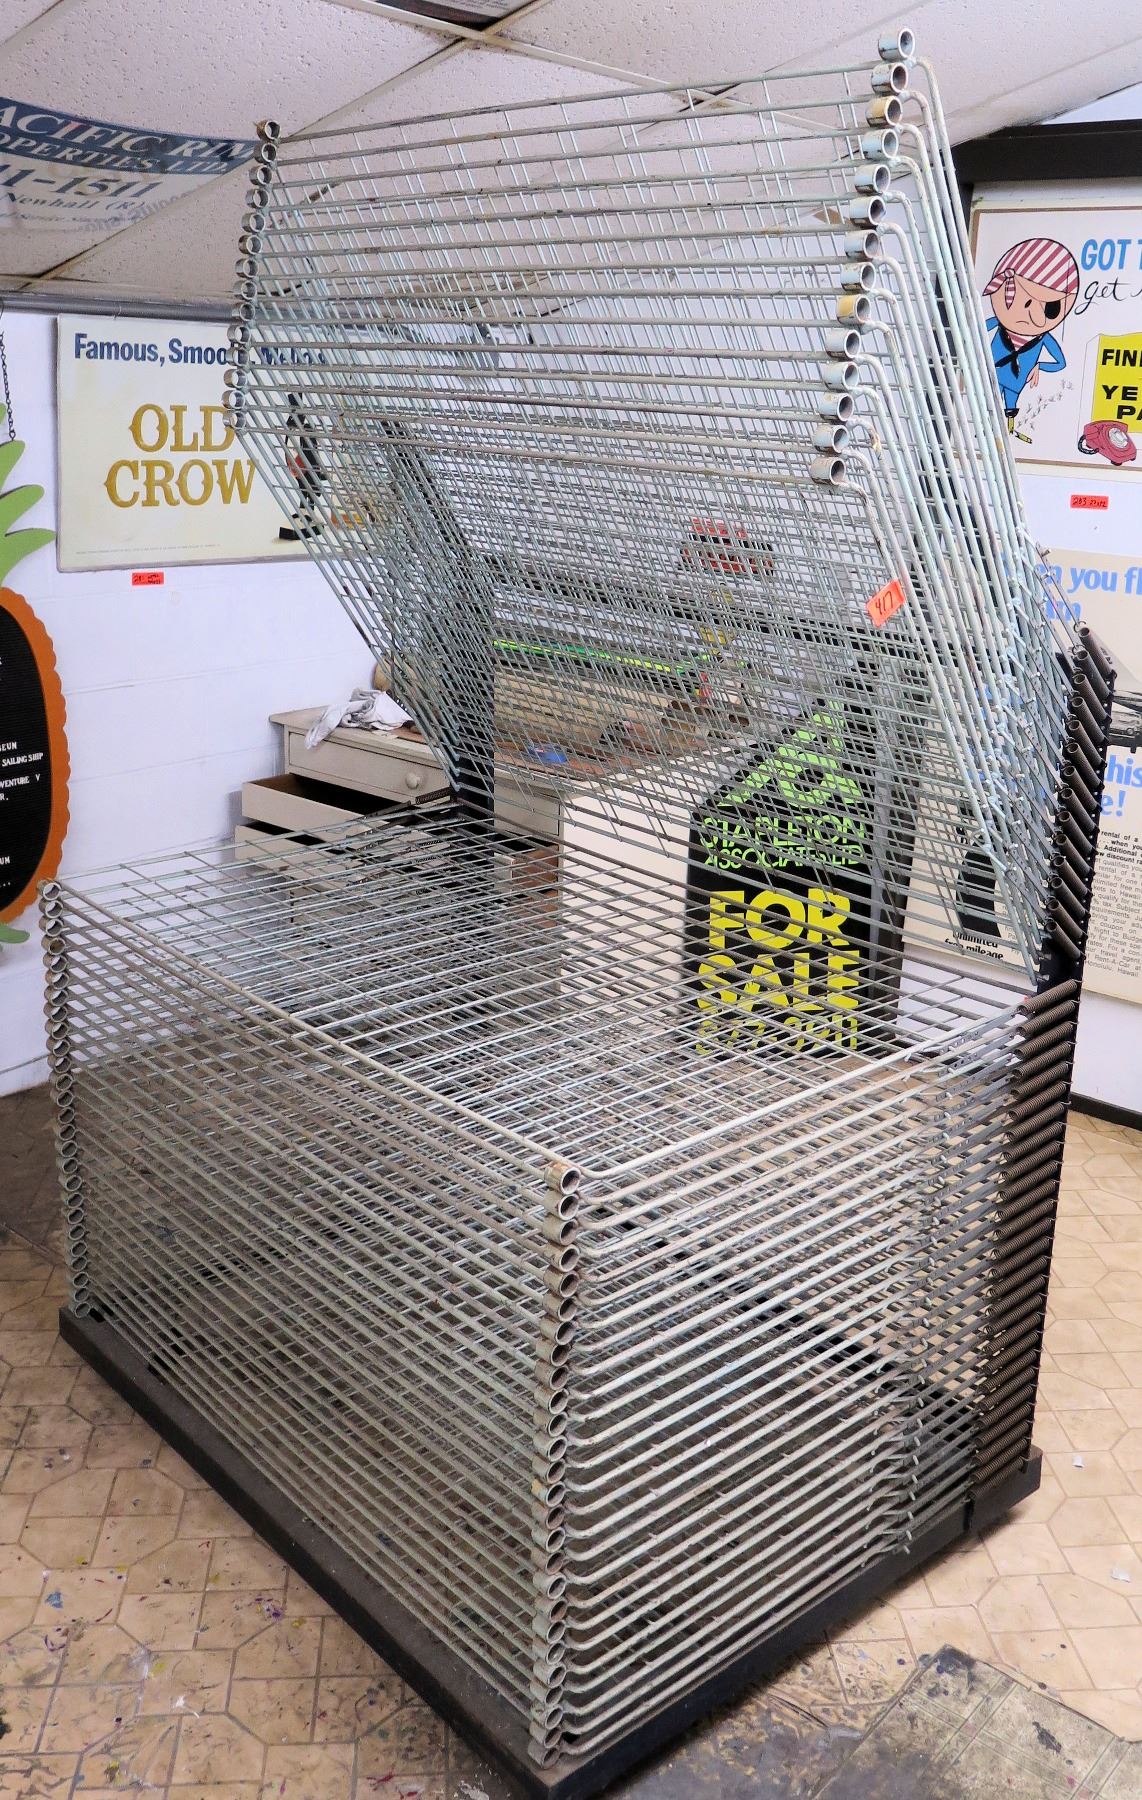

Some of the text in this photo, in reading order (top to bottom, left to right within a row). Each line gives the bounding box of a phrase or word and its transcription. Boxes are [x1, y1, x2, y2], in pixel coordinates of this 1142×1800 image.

[1081, 239, 1132, 271] GOT
[1074, 276, 1130, 316] get
[74, 333, 166, 367] Famous,
[128, 403, 236, 453] OLD
[103, 459, 259, 508] CROW
[1067, 567, 1118, 594] you
[1, 752, 44, 767] SAILING SHIP
[1104, 754, 1142, 788] his
[1101, 831, 1121, 839] rental
[1104, 845, 1138, 857] Additional
[1106, 853, 1135, 863] discount
[709, 887, 851, 951] FOR
[696, 949, 860, 1015] SALE
